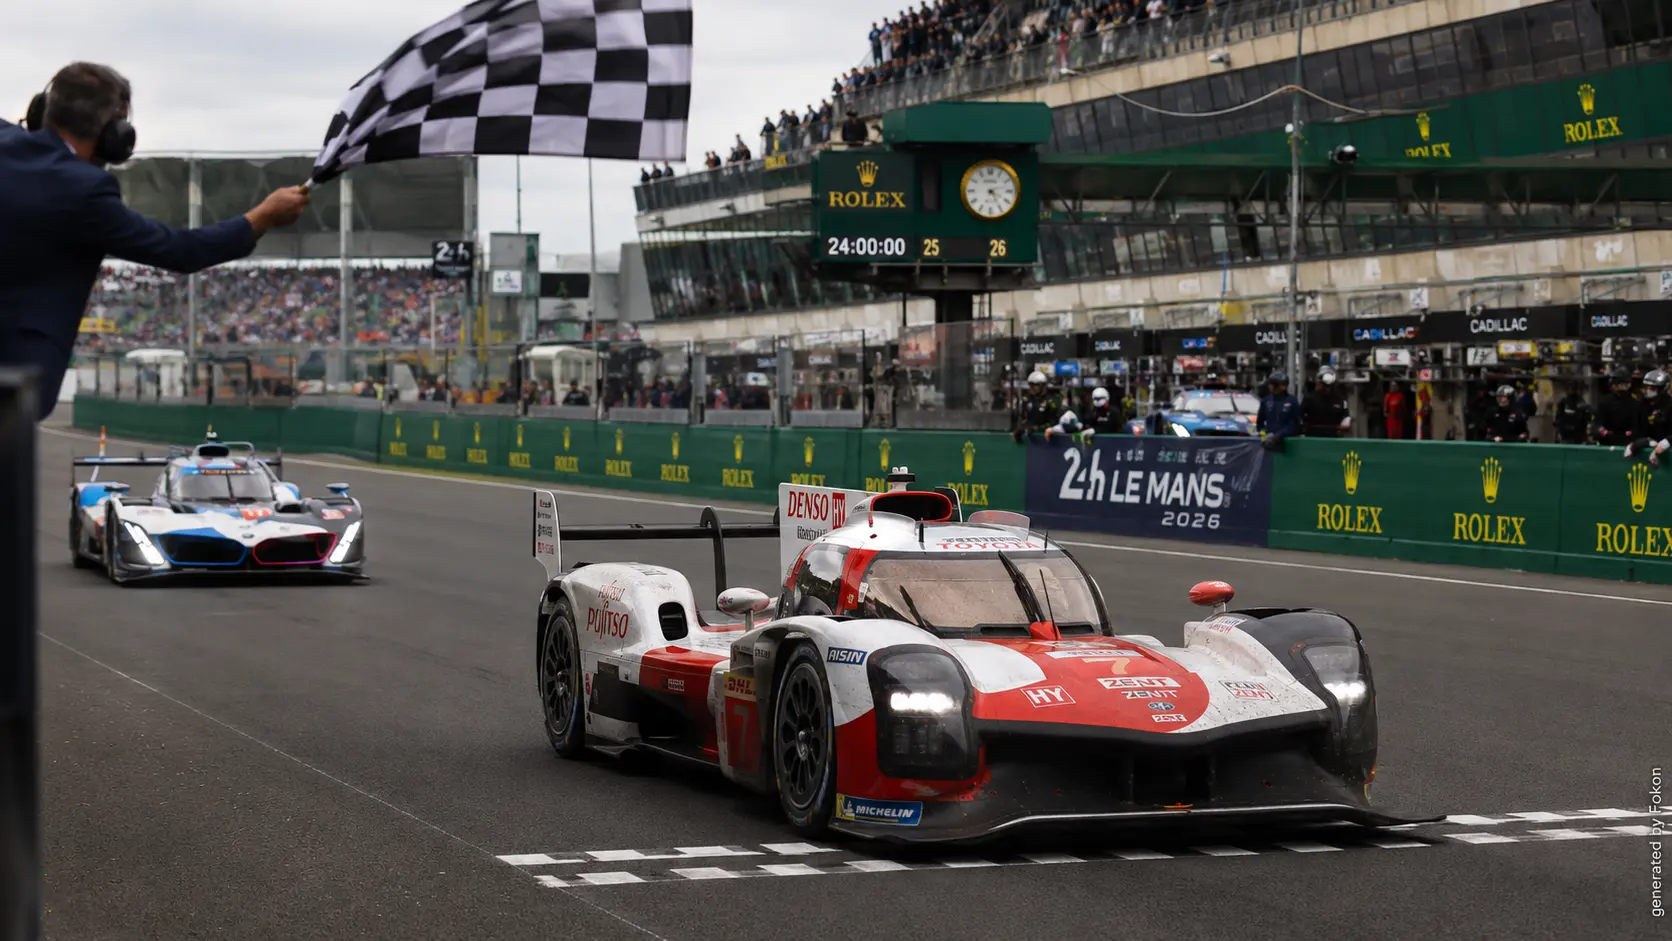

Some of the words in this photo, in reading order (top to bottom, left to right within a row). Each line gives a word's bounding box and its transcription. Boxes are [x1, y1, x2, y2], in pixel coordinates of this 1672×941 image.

[1564, 117, 1623, 143] ROLEX
[829, 191, 906, 208] ROLEX
[828, 237, 906, 256] 24:00:00
[923, 238, 940, 257] 25
[990, 239, 1007, 257] 26
[1353, 326, 1416, 341] CADILLAC
[1470, 317, 1528, 333] CADILLAC
[661, 464, 689, 482] ROLEX
[722, 468, 754, 488] ROLEX
[1109, 470, 1144, 504] LE
[1146, 470, 1226, 509] MANS
[788, 490, 829, 521] DENSO
[1161, 512, 1221, 529] 2026
[1317, 503, 1383, 533] ROLEX
[1453, 512, 1526, 545] ROLEX
[936, 542, 1040, 551] TOYOTA
[1596, 522, 1672, 557] ROLEX
[828, 650, 865, 664] AISIN
[1082, 657, 1130, 675] 7
[1026, 687, 1064, 704] HY
[855, 804, 914, 818] MICHELIN
